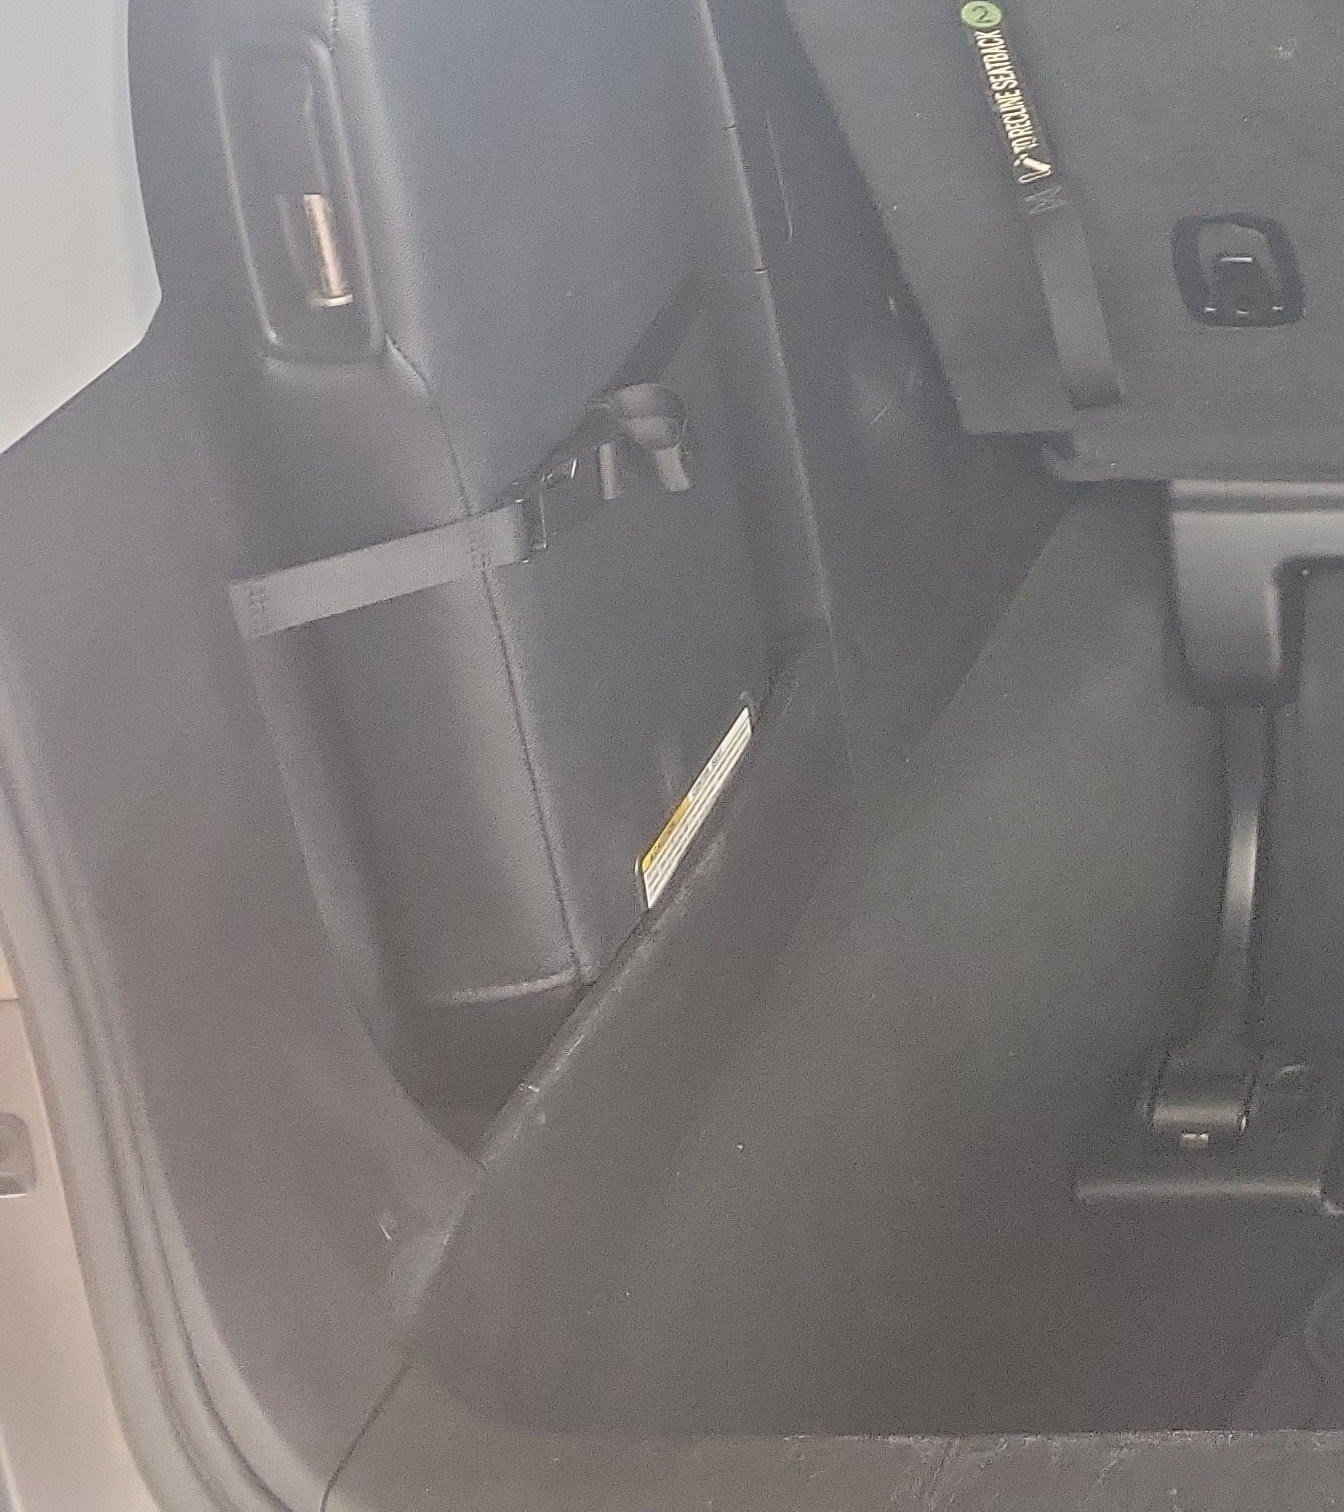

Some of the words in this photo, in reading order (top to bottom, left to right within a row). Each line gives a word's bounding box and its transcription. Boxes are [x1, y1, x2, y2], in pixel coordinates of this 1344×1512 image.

[973, 29, 1018, 92] SEATBACK
[993, 88, 1036, 142] RECLINE
[1010, 136, 1040, 155] TO
